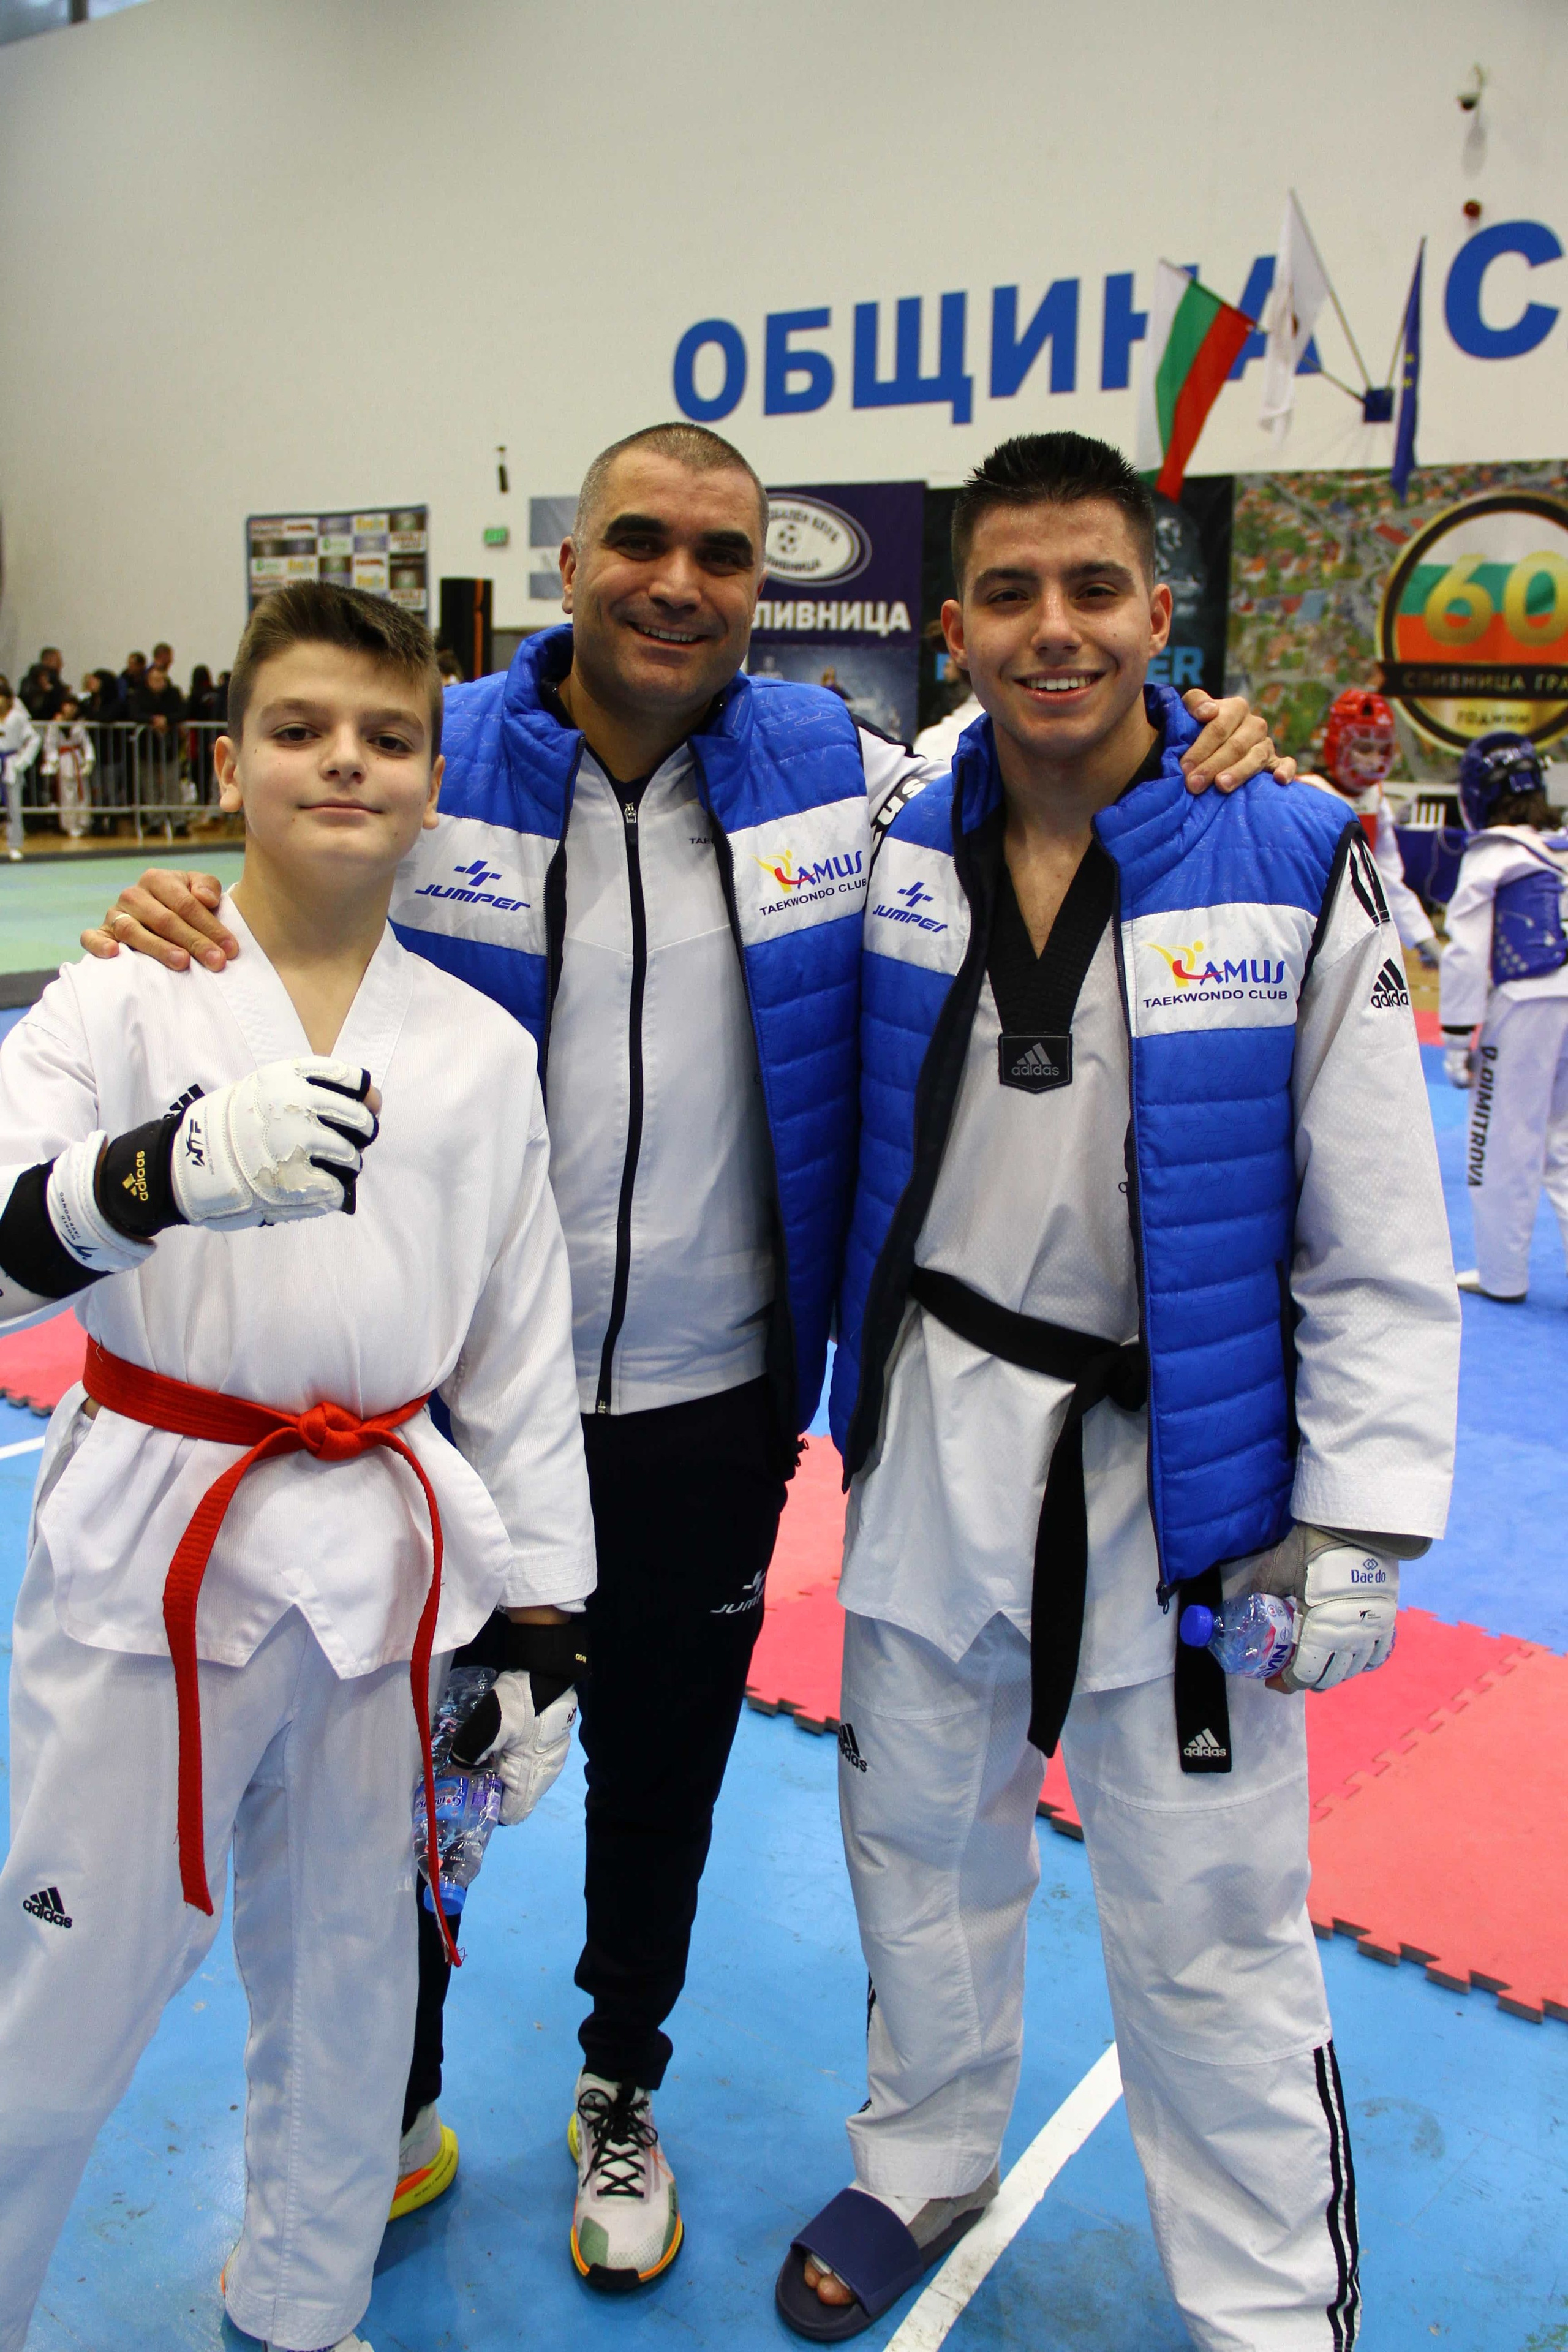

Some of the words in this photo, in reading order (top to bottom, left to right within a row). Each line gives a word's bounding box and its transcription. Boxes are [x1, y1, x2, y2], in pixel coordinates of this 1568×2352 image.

[1424, 551, 1568, 647] 60
[752, 601, 911, 638] ЛИВНИЦА
[415, 884, 531, 911] JUMPER
[760, 887, 835, 916] TAEKWONDO
[839, 878, 867, 892] CLUB
[873, 905, 948, 933] JUMPER
[1143, 990, 1244, 1008] TAEKWONDO
[1248, 990, 1287, 1000] CLUB
[1371, 989, 1409, 1008] adida
[1011, 1064, 1060, 1076] adidas
[135, 1151, 149, 1201] adidas
[1183, 1746, 1226, 1757] adidas
[23, 1899, 72, 1929] adidas
